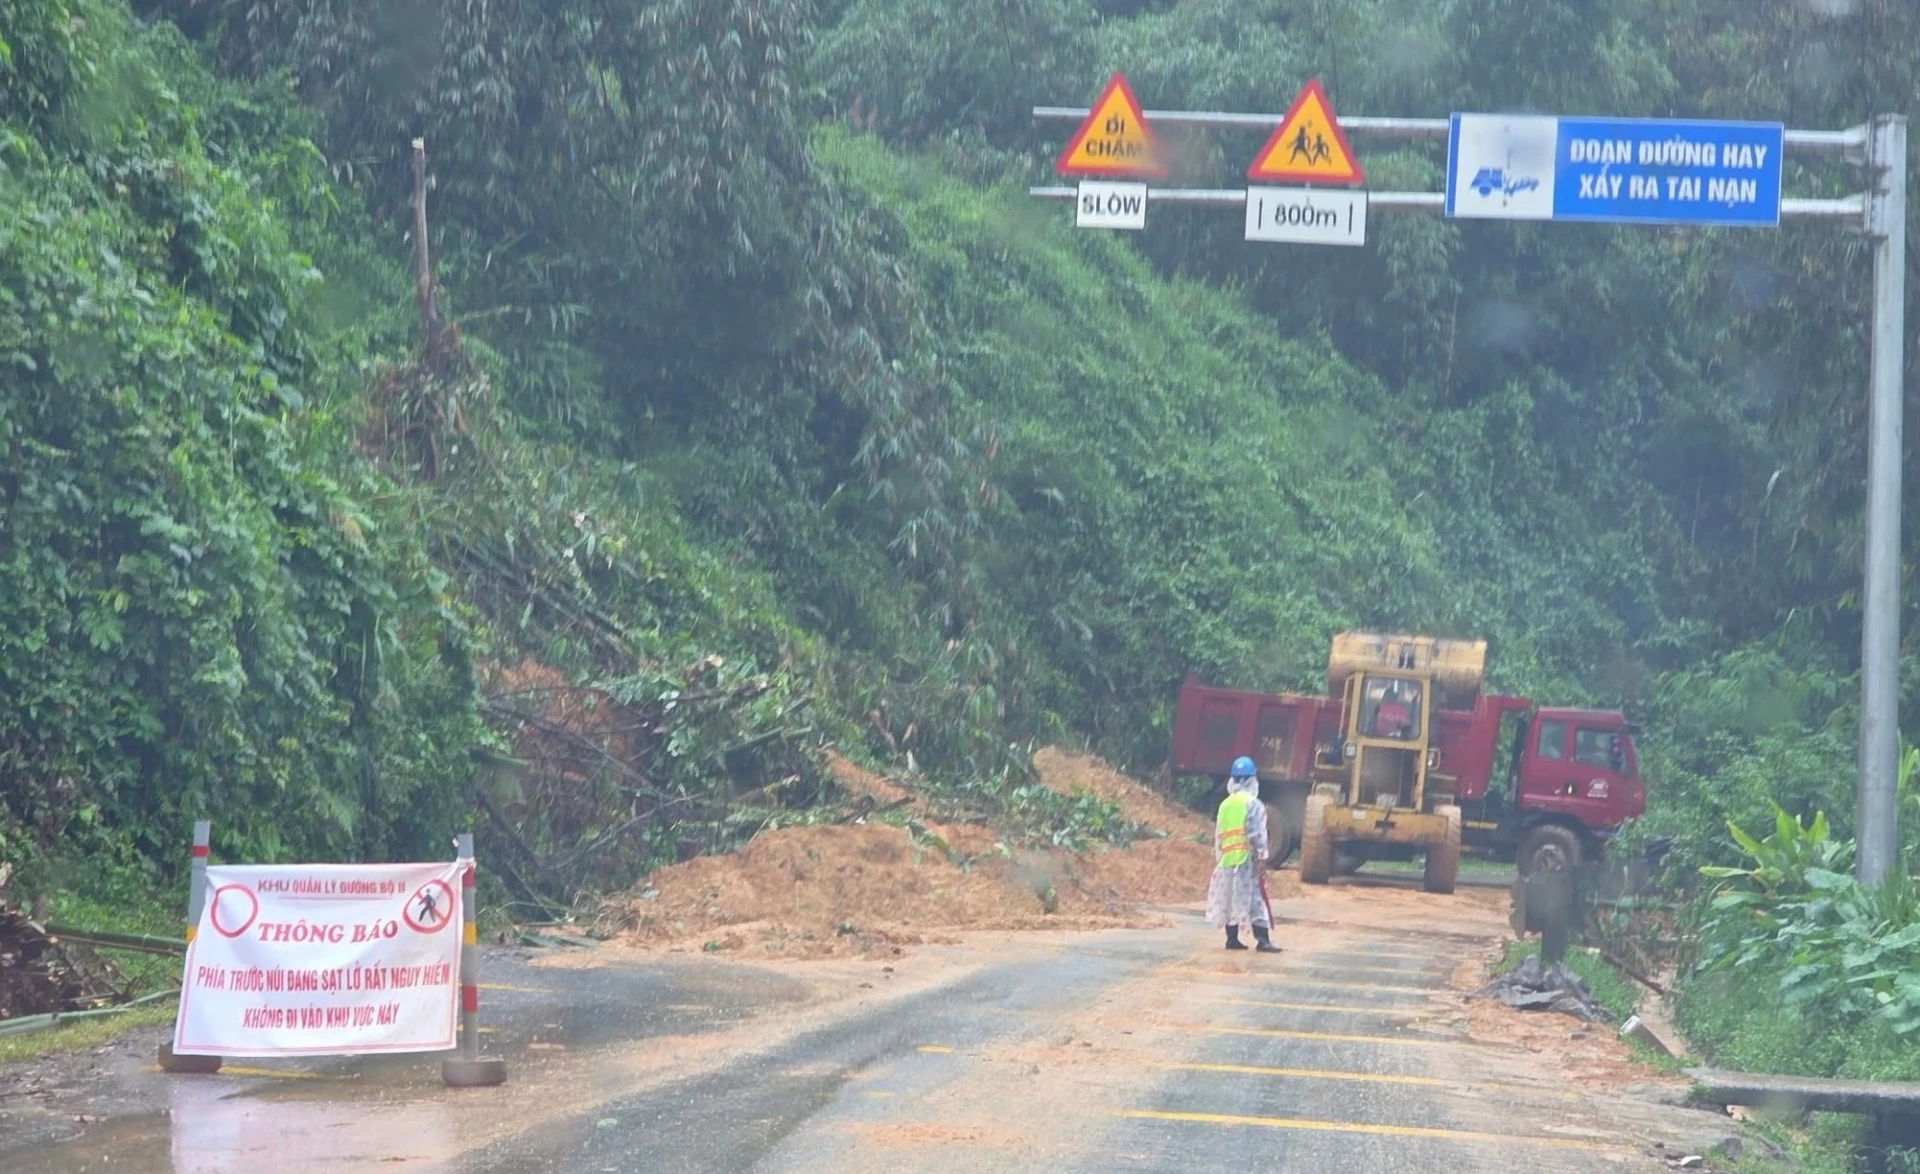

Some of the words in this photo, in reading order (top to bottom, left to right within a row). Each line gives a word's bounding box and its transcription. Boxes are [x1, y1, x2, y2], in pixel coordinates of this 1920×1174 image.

[1722, 143, 1768, 169] HAY
[1628, 174, 1659, 200] RA
[1667, 176, 1701, 202] TAI
[1707, 177, 1757, 208] NẠN
[1082, 194, 1141, 216] SLOW
[1274, 203, 1337, 228] 800m
[258, 878, 291, 893] KHU
[258, 919, 345, 943] THÔNG
[350, 918, 398, 943] BÁO
[196, 963, 225, 990] PHÍA
[229, 965, 264, 992] TRƯỚC
[265, 964, 285, 992] NÚI
[286, 969, 318, 992] ĐANG
[321, 969, 343, 995] SẠT
[364, 959, 387, 990] RẤT
[390, 966, 421, 990] NGUY
[243, 1003, 283, 1029] KHÔNG
[285, 1008, 298, 1029] ĐI
[300, 1003, 322, 1029] VÀO
[326, 1007, 350, 1029] KHU
[352, 1004, 376, 1031] VỰC
